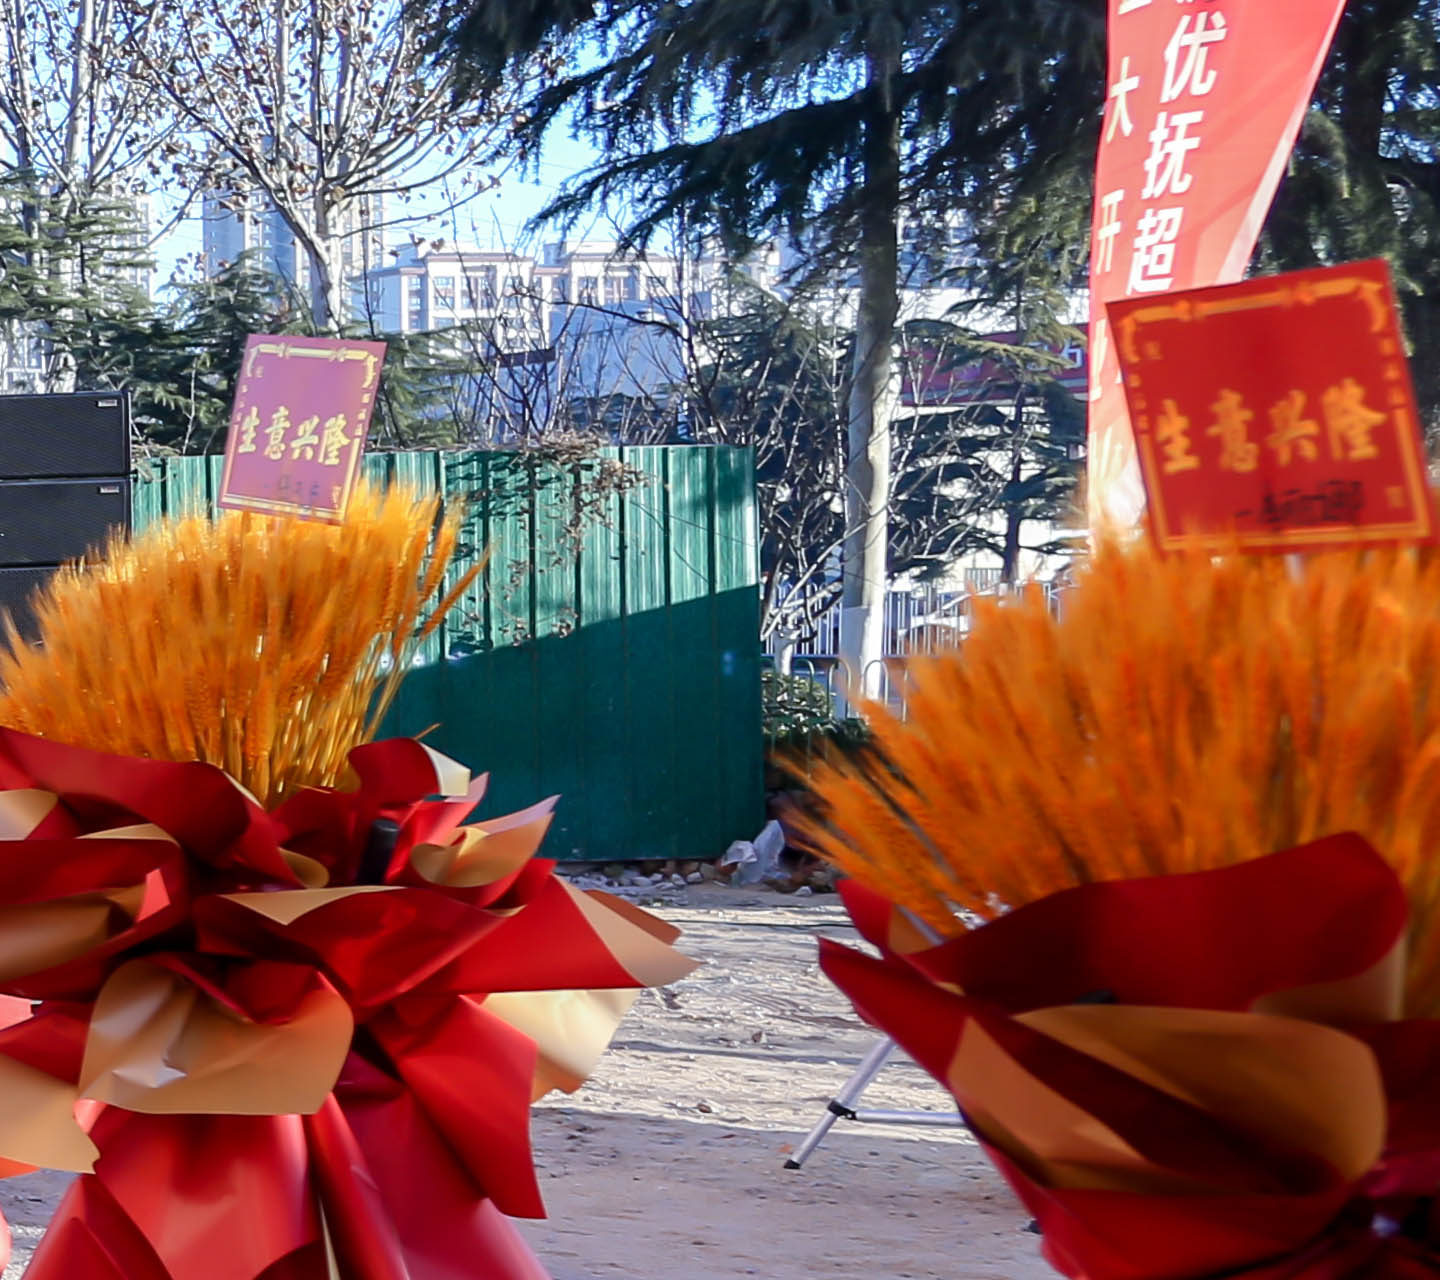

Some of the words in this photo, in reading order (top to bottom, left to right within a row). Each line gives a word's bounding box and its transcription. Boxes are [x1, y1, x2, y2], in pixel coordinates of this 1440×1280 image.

[238, 405, 351, 466] 生意兴隆
[1155, 376, 1386, 475] 生意兴隆
